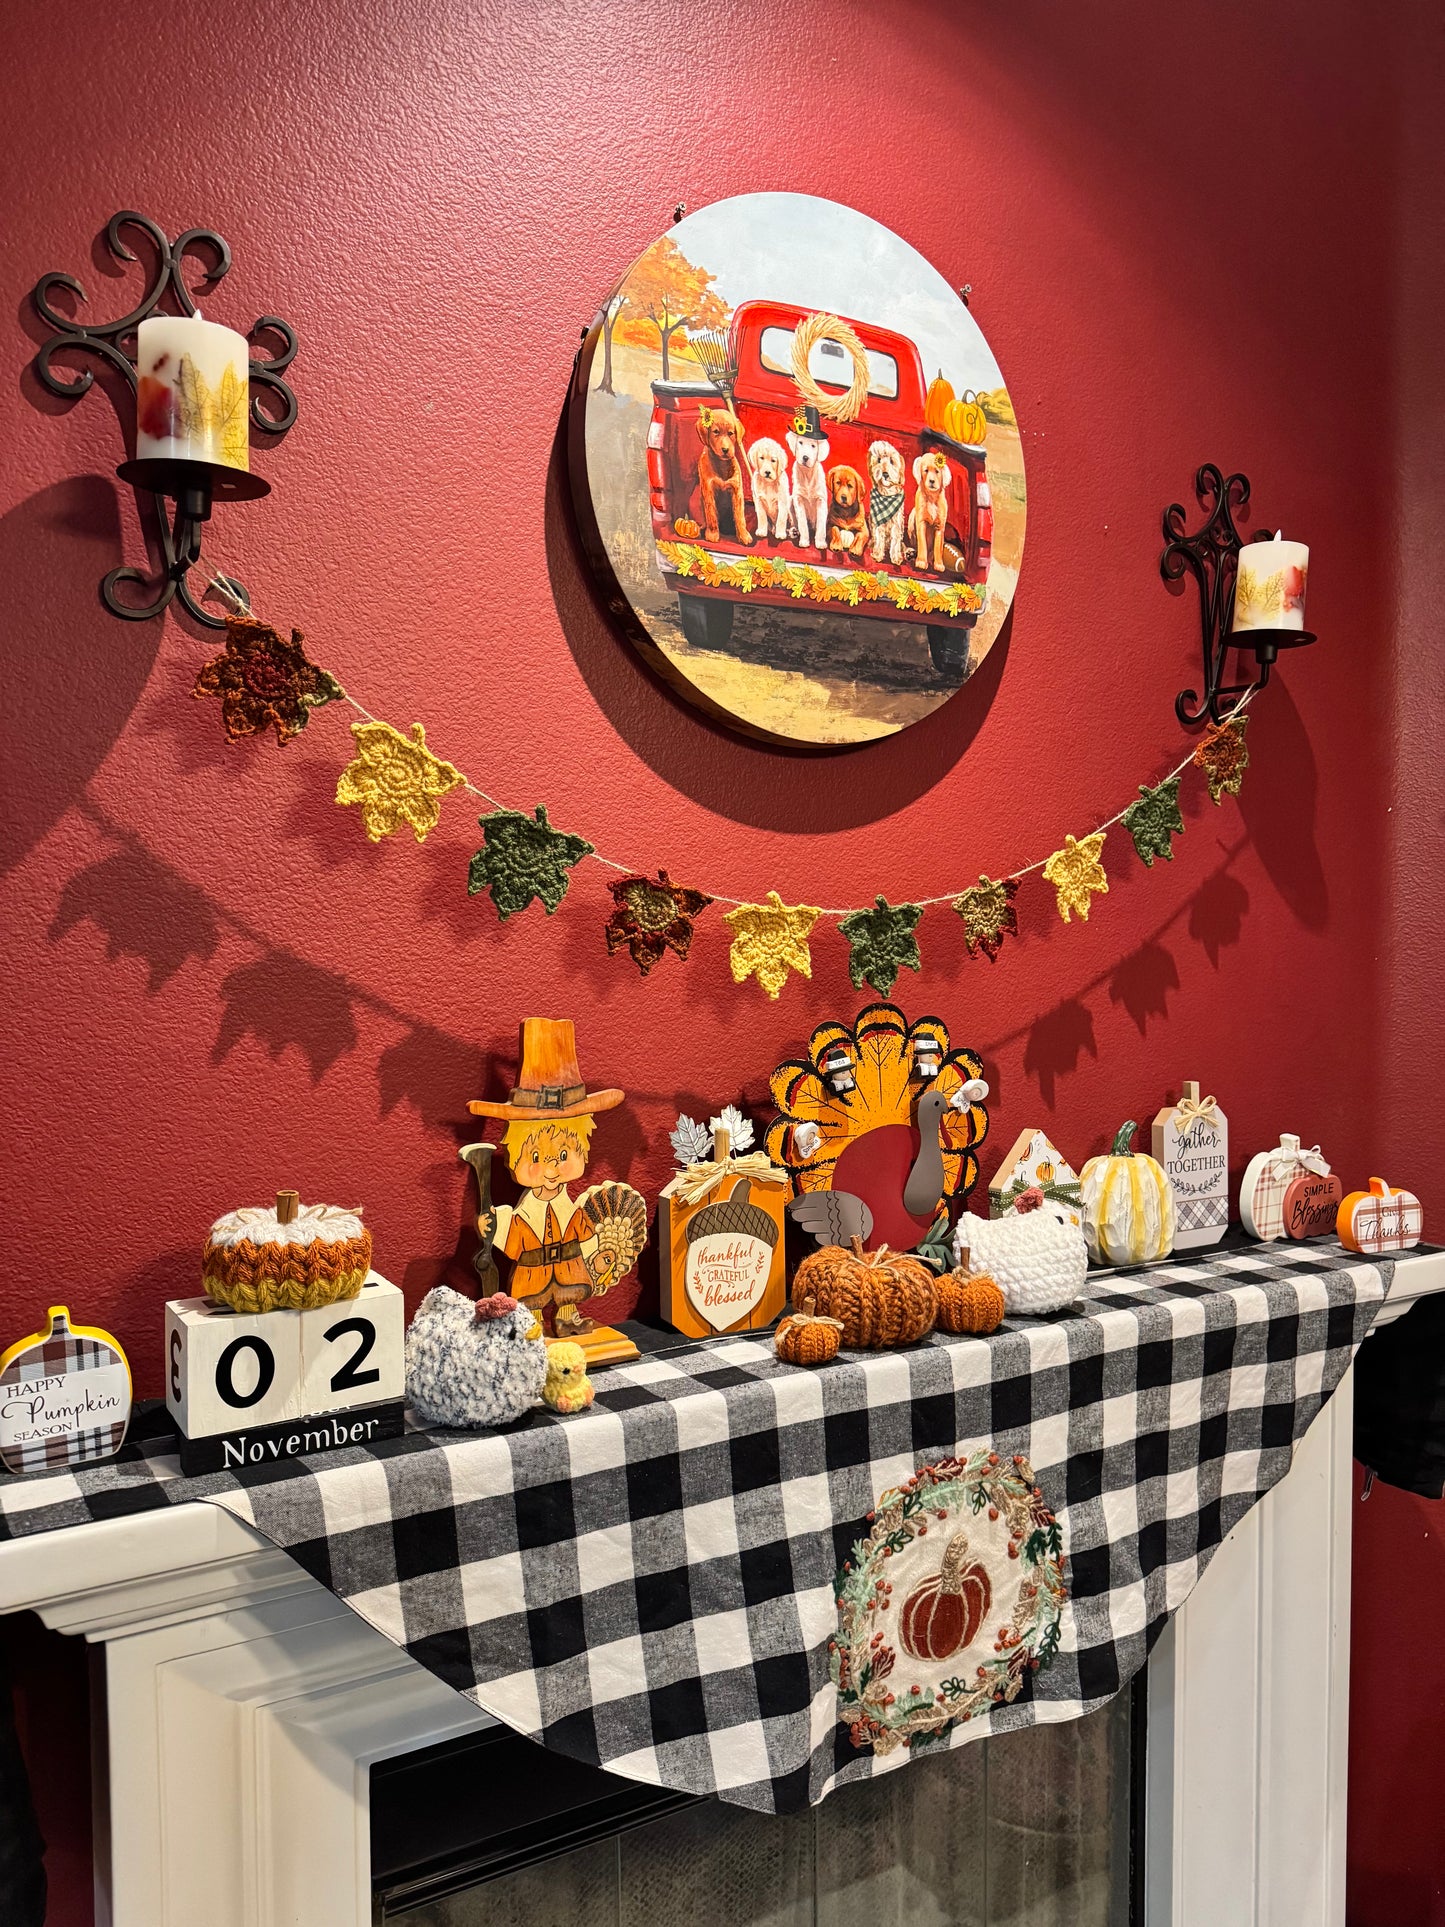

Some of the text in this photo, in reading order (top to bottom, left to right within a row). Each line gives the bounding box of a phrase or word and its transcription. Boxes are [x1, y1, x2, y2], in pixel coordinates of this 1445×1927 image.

[1172, 1122, 1221, 1159] gather
[1167, 1155, 1226, 1174] TOGETHER
[1304, 1182, 1334, 1198] SIMPLE
[1291, 1197, 1338, 1230] Blessings
[1360, 1215, 1410, 1241] Thanks
[698, 1240, 755, 1269] thankful
[707, 1269, 749, 1282] GRATEFUL
[704, 1279, 755, 1306] blessed
[7, 1376, 66, 1398] HAPPY
[1, 1388, 120, 1428] Pumpkin
[14, 1422, 72, 1442] SEASON
[222, 1418, 379, 1469] November
